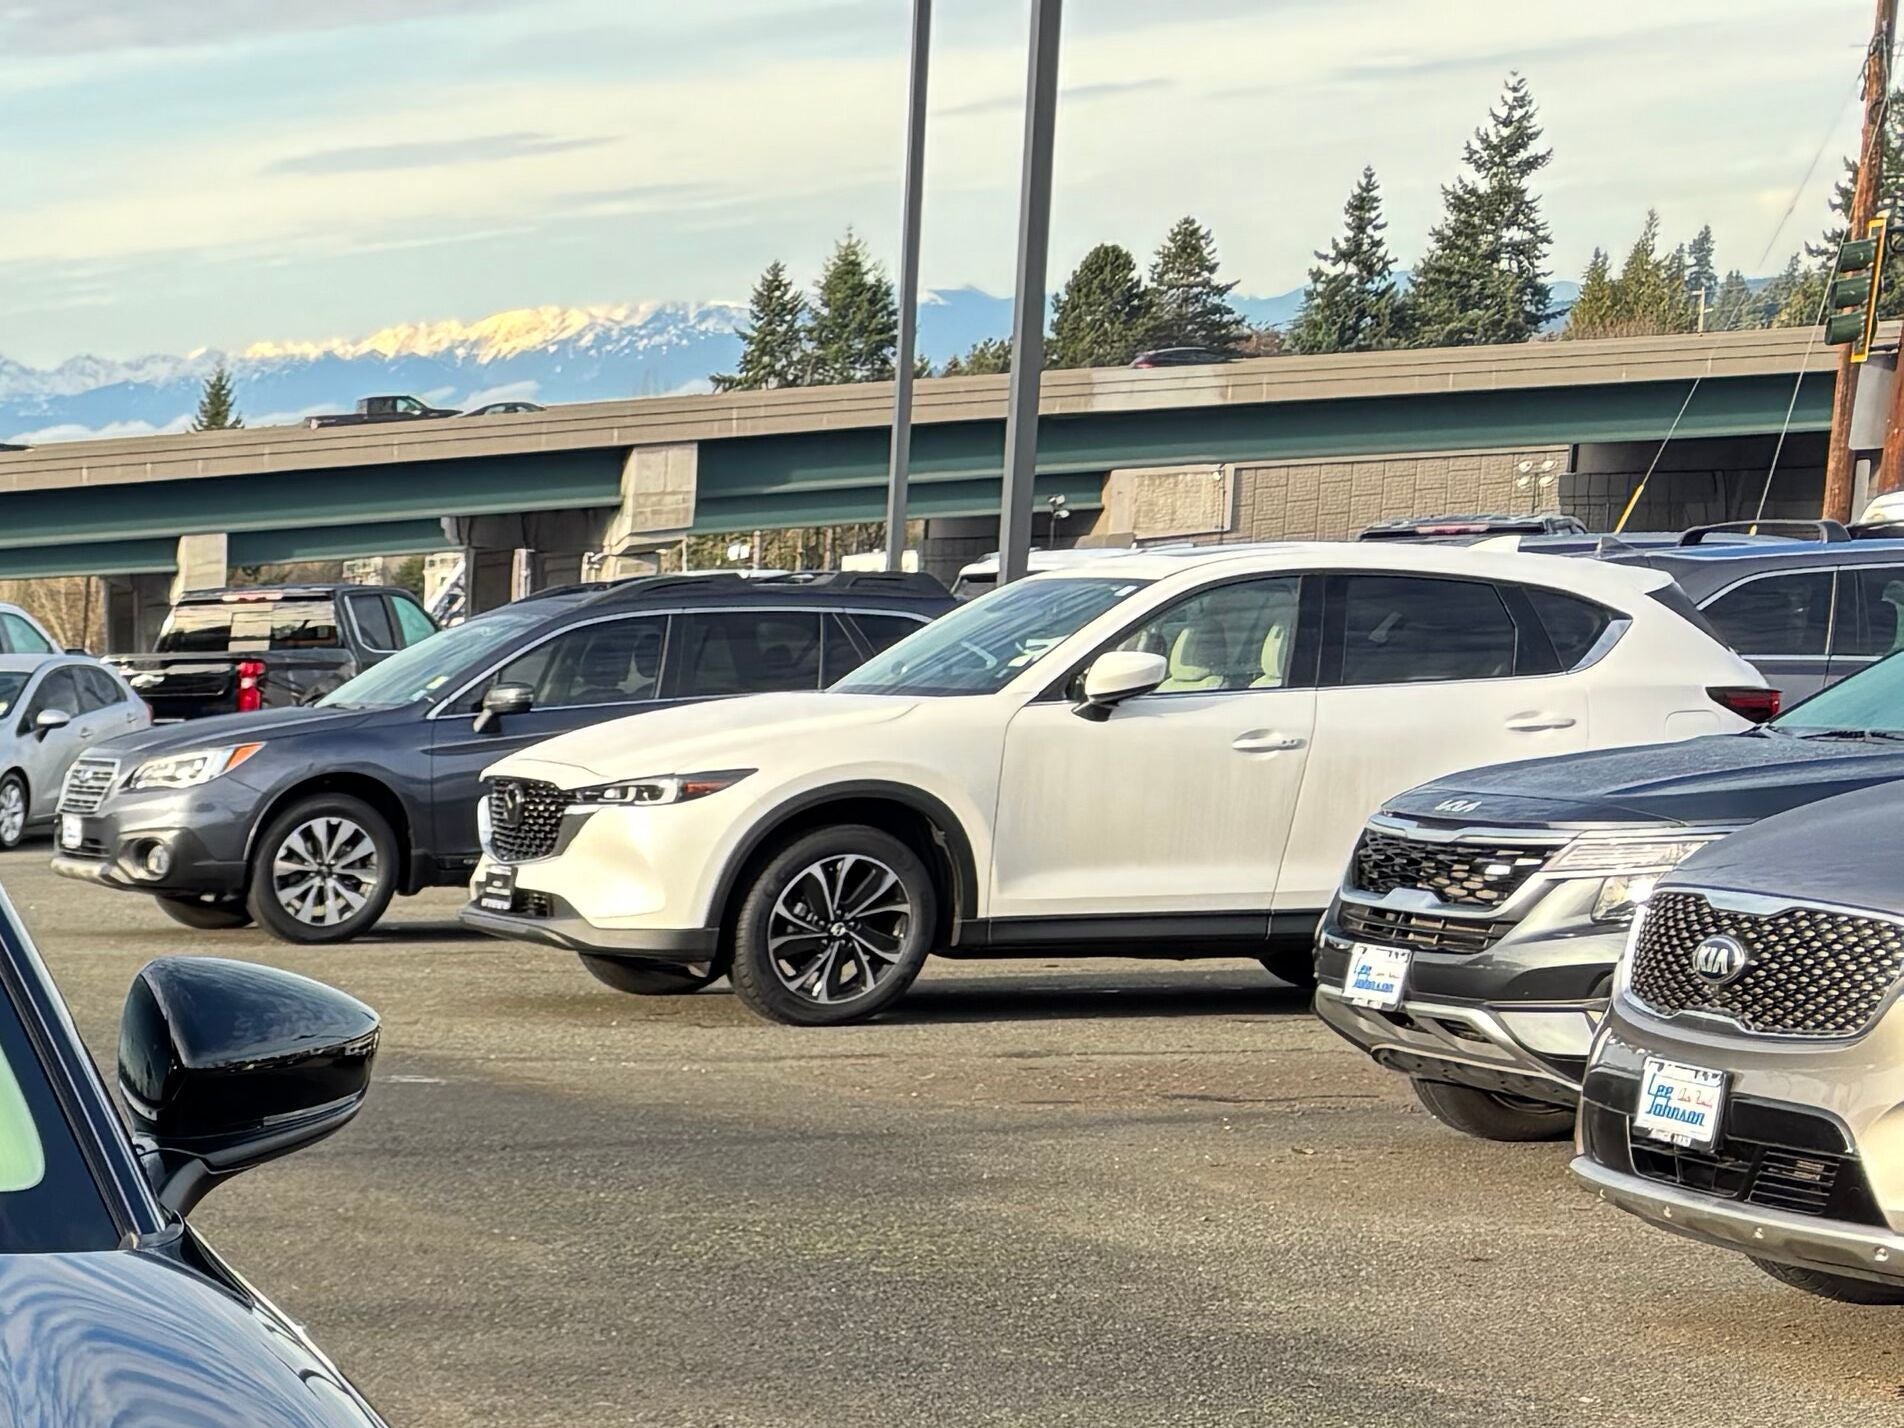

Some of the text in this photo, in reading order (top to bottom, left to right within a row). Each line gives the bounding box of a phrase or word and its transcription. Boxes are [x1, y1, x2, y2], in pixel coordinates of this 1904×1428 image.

[1696, 946, 1729, 975] KIA
[1648, 1073, 1674, 1099] Lee
[1645, 1097, 1705, 1127] Johnson
